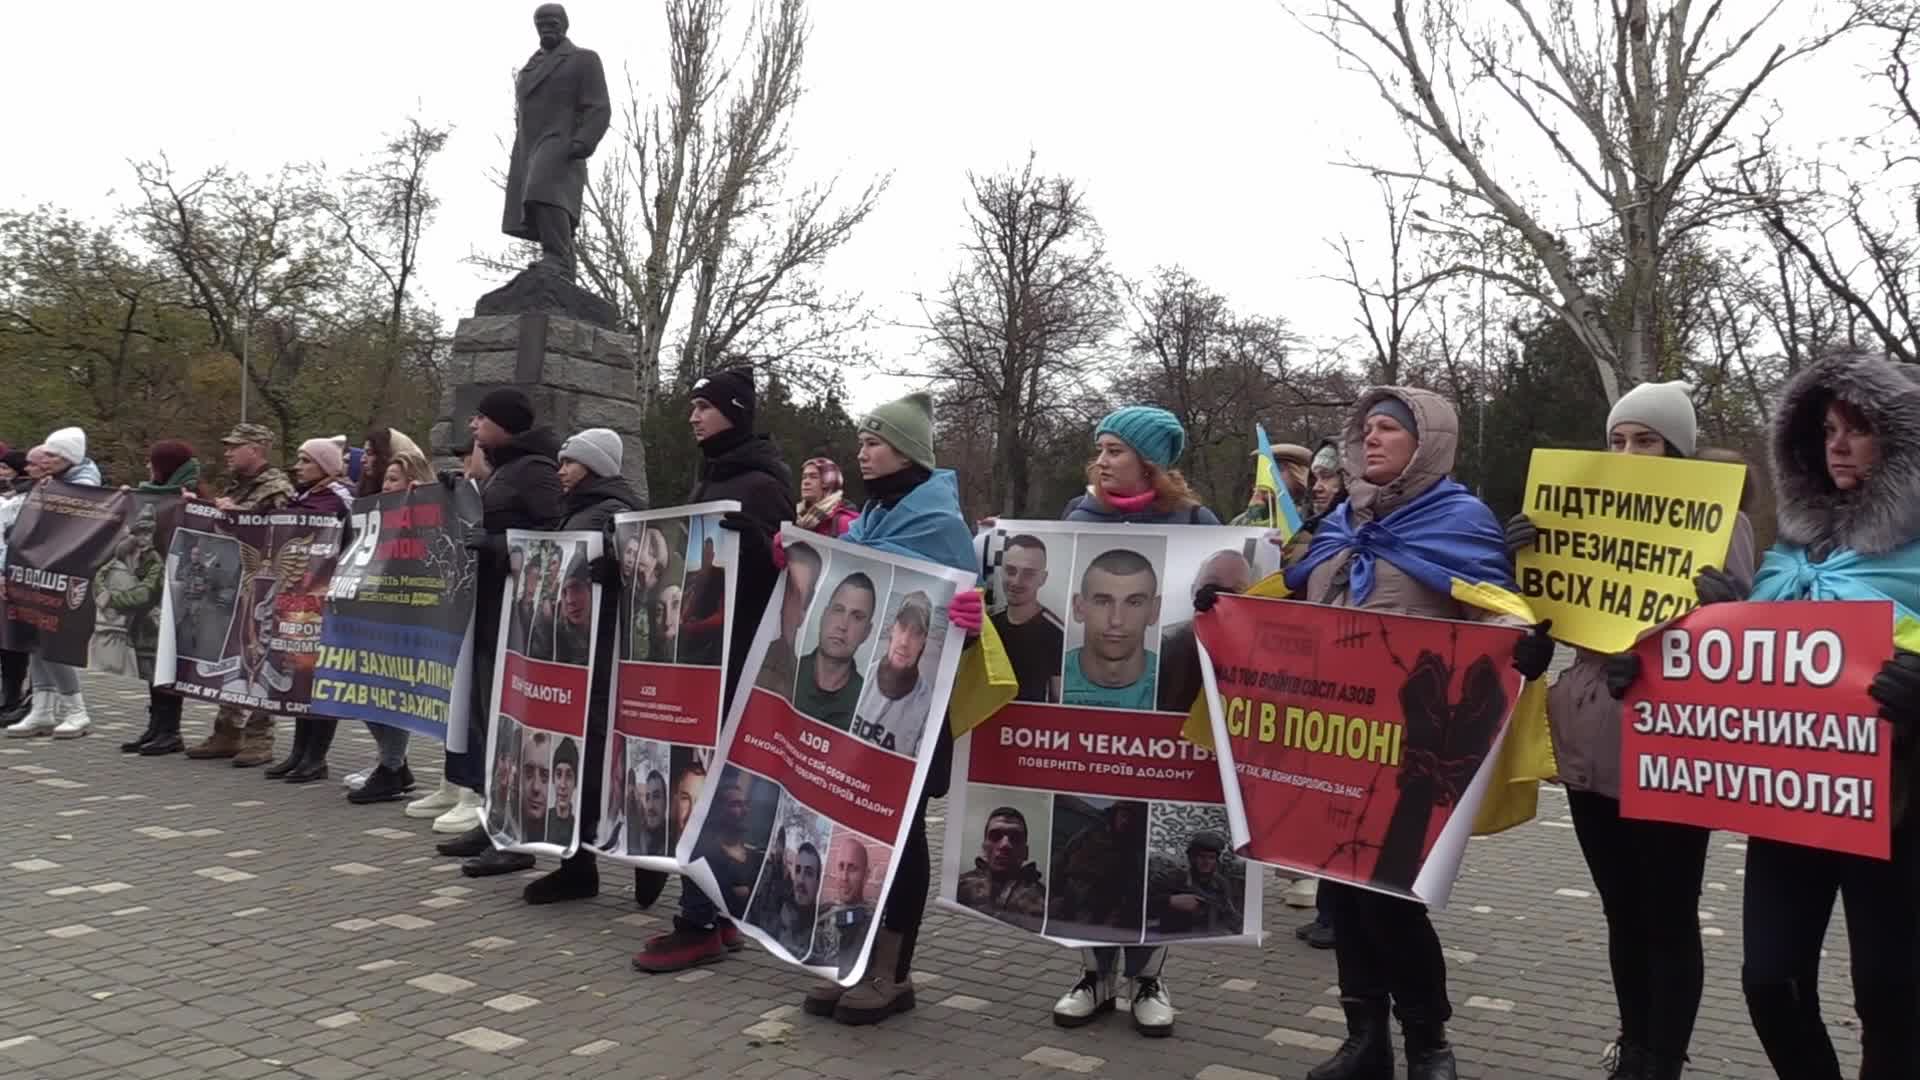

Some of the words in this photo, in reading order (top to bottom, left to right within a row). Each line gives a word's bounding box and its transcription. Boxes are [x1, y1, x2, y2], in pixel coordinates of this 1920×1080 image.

[1534, 483, 1724, 534] ПІДТРИМУЄМО
[339, 510, 381, 567] 79
[1534, 527, 1693, 580] ПРЕЗИДЕНТА
[9, 565, 24, 583] 79
[1521, 566, 1594, 608] ВСІХ
[1599, 579, 1632, 618] НА
[1660, 628, 1843, 686] ВОЛЮ
[799, 730, 830, 753] АЗОВ
[1000, 726, 1070, 751] ВОНИ
[1258, 702, 1277, 742] В
[1283, 706, 1402, 766] ПОЛОНІ
[1632, 701, 1878, 753] ЗАХИСНИКАМ
[1017, 756, 1086, 772] ПОВЕРНІТЬ
[1088, 762, 1134, 777] ГЕРОЇВ
[1135, 768, 1195, 781] ДОДОМУ
[1638, 753, 1874, 819] МАРІУПОЛЯ!
